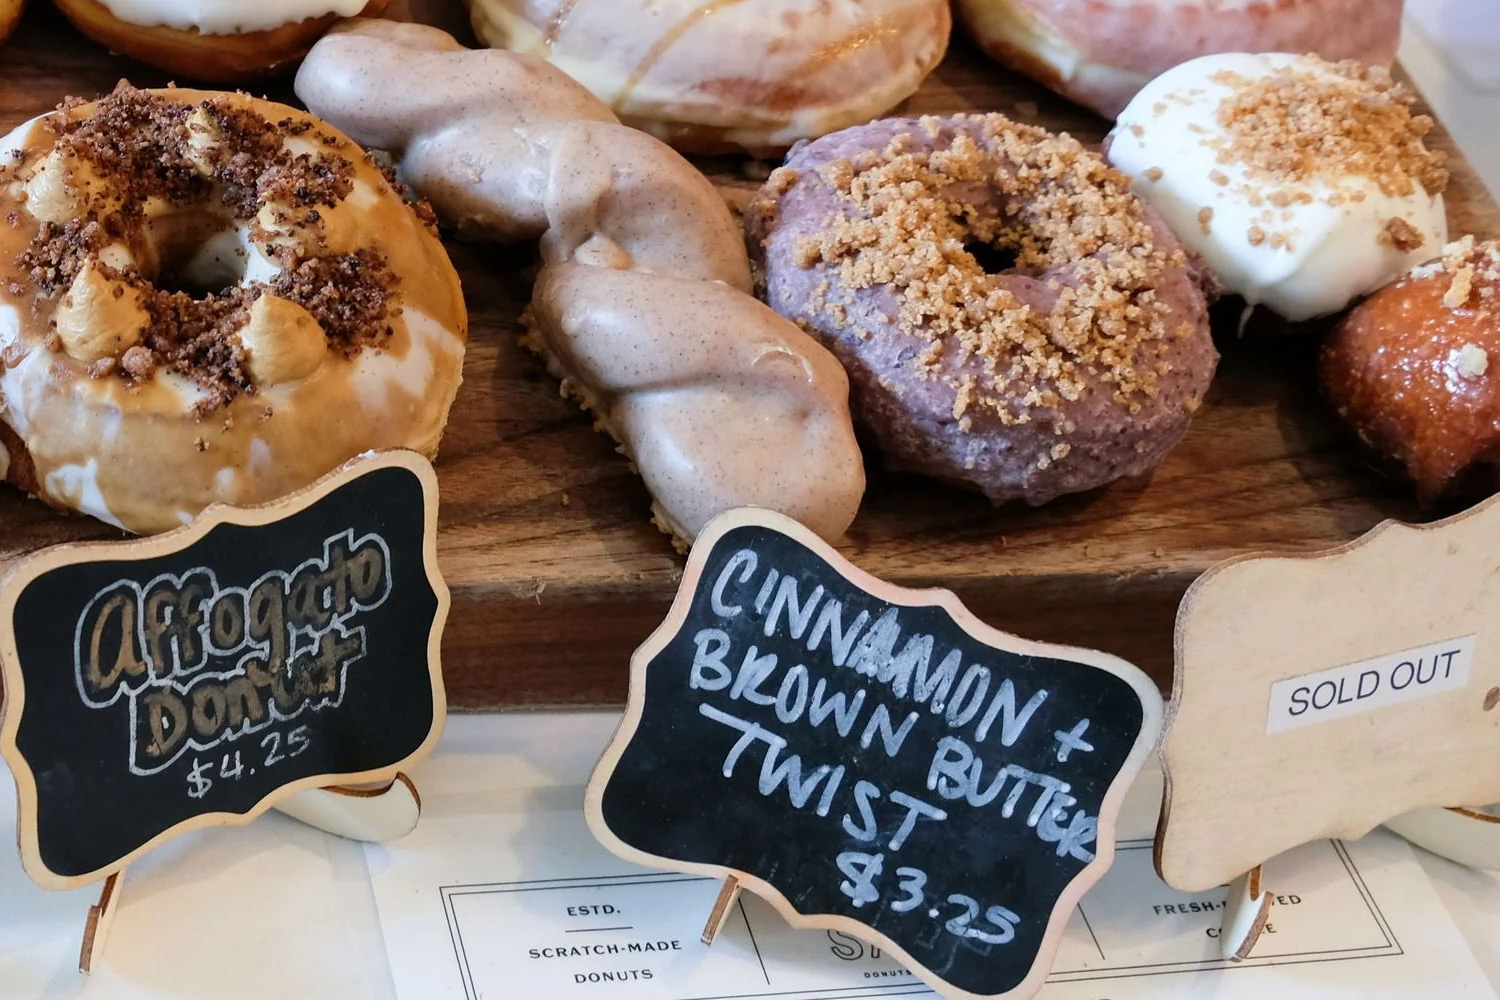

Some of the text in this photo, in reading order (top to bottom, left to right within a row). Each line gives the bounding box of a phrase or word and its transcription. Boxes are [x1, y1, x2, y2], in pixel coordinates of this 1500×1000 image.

[710, 548, 1049, 747] CINNAMON
[1288, 649, 1461, 716] SOLD OUT
[187, 725, 310, 798] $4.25
[689, 629, 1098, 864] BROWN BUTTER
[700, 703, 947, 852] TWIST
[566, 904, 621, 917] ESTD.
[835, 852, 1022, 945] $3.25
[1152, 894, 1302, 915] FRESH-ED
[529, 939, 683, 959] SCRATCH-MADE
[574, 969, 654, 984] DONUTS
